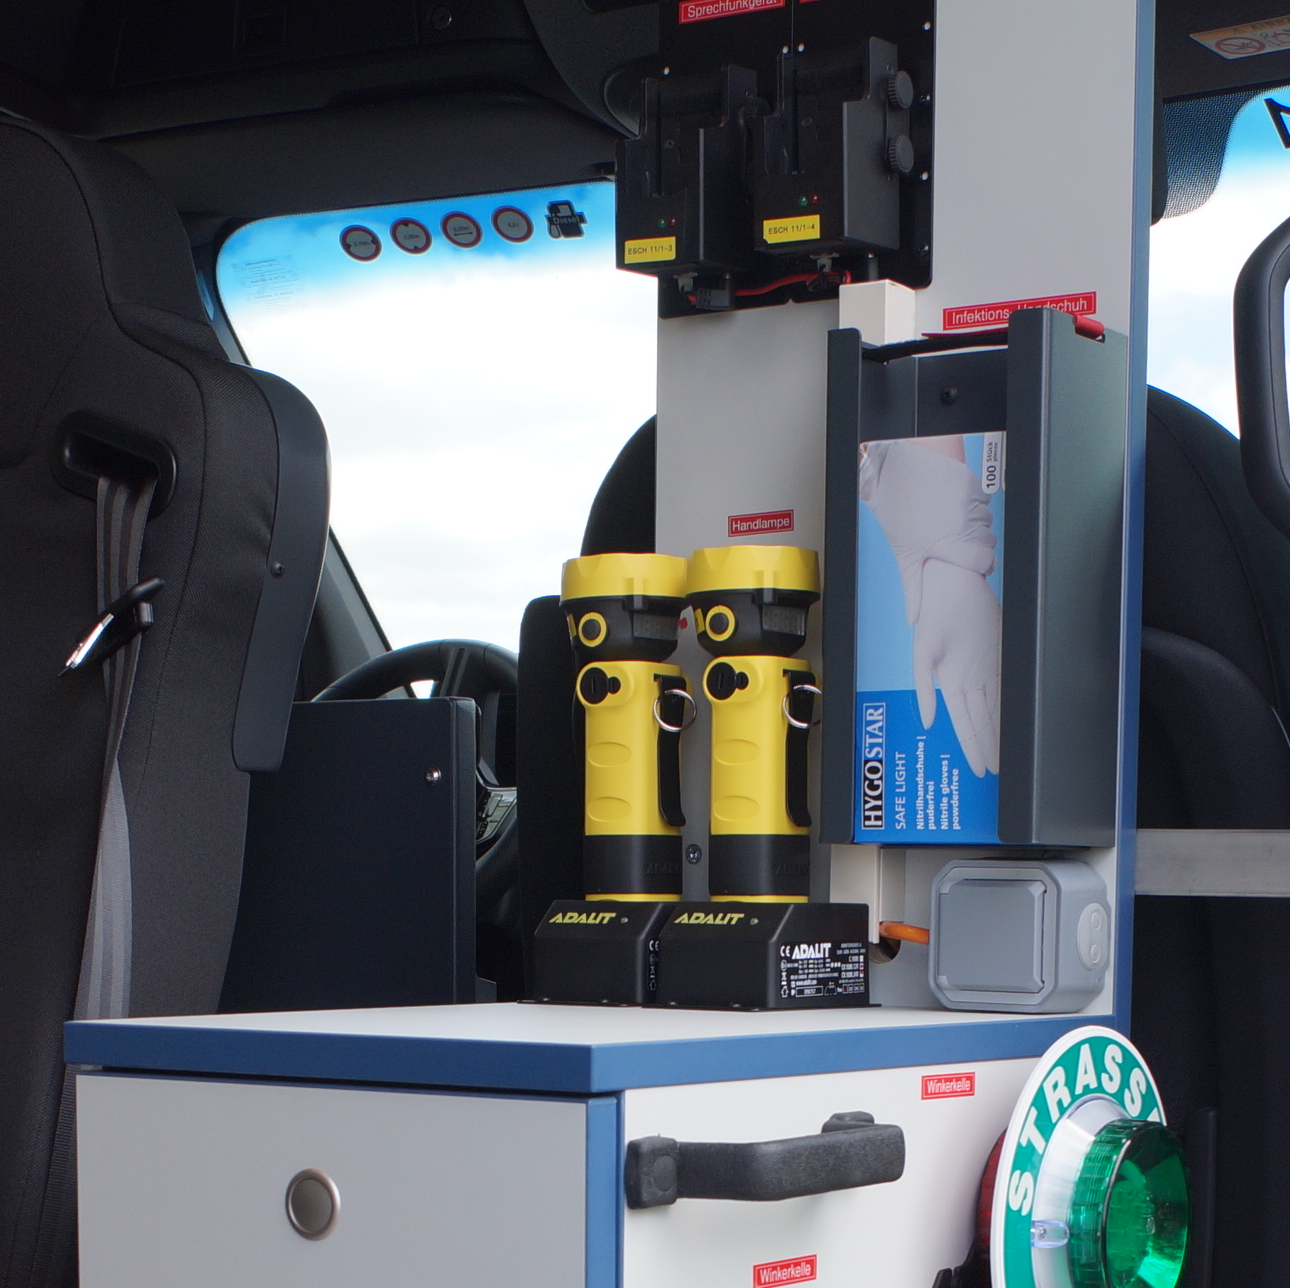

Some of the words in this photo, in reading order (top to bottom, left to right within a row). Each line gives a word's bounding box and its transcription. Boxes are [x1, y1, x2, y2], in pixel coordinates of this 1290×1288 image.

[552, 215, 580, 225] Diesel
[768, 226, 789, 235] ESCH
[791, 223, 815, 233] 11/1-4
[628, 246, 648, 255] ESCH
[650, 244, 673, 254] 11/1-3
[986, 465, 996, 489] 100
[732, 518, 790, 532] Handlampe
[864, 707, 884, 827] HYGOSTAR
[895, 751, 906, 793] LIGHT
[940, 760, 950, 795] gloves
[916, 741, 925, 830] Nitrilhandschuhe
[926, 781, 937, 830] puderfrei
[951, 768, 961, 830] powderfree
[895, 796, 906, 830] SAFE
[940, 796, 949, 830] Nitrile
[549, 912, 616, 924] ADALIT
[674, 912, 745, 925] ADALIT
[791, 942, 832, 960] ADALIT
[927, 1077, 971, 1094] Winkerkelle
[1009, 1042, 1162, 1216] STRASS
[760, 1262, 811, 1284] Winkerkelle
